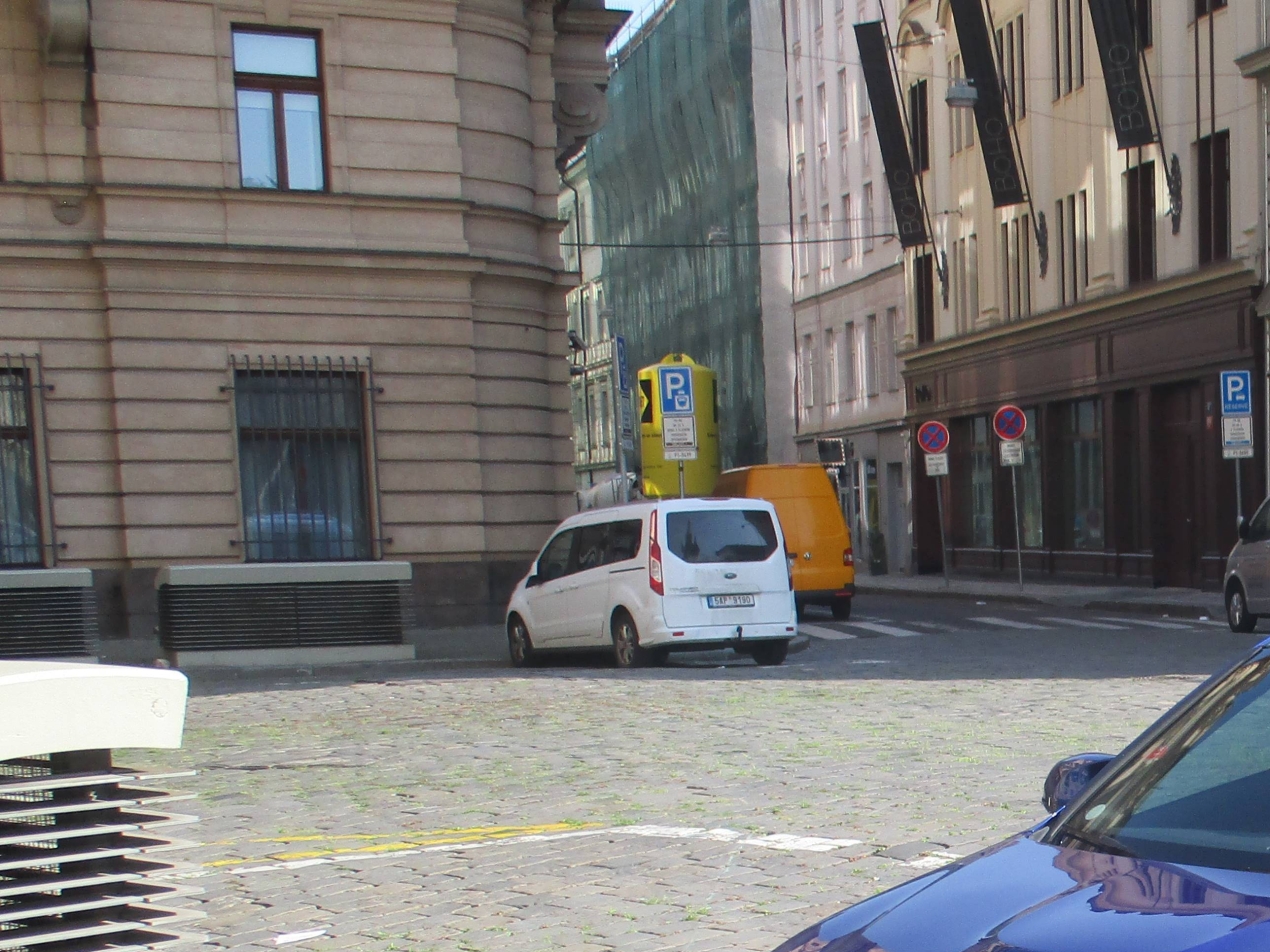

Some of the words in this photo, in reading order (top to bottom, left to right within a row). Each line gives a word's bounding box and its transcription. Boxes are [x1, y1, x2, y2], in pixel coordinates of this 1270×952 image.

[1108, 44, 1145, 131] BOHO
[985, 118, 1017, 191] BOHO
[894, 169, 921, 235] BOHO
[665, 372, 685, 400] P
[1227, 375, 1244, 401] P
